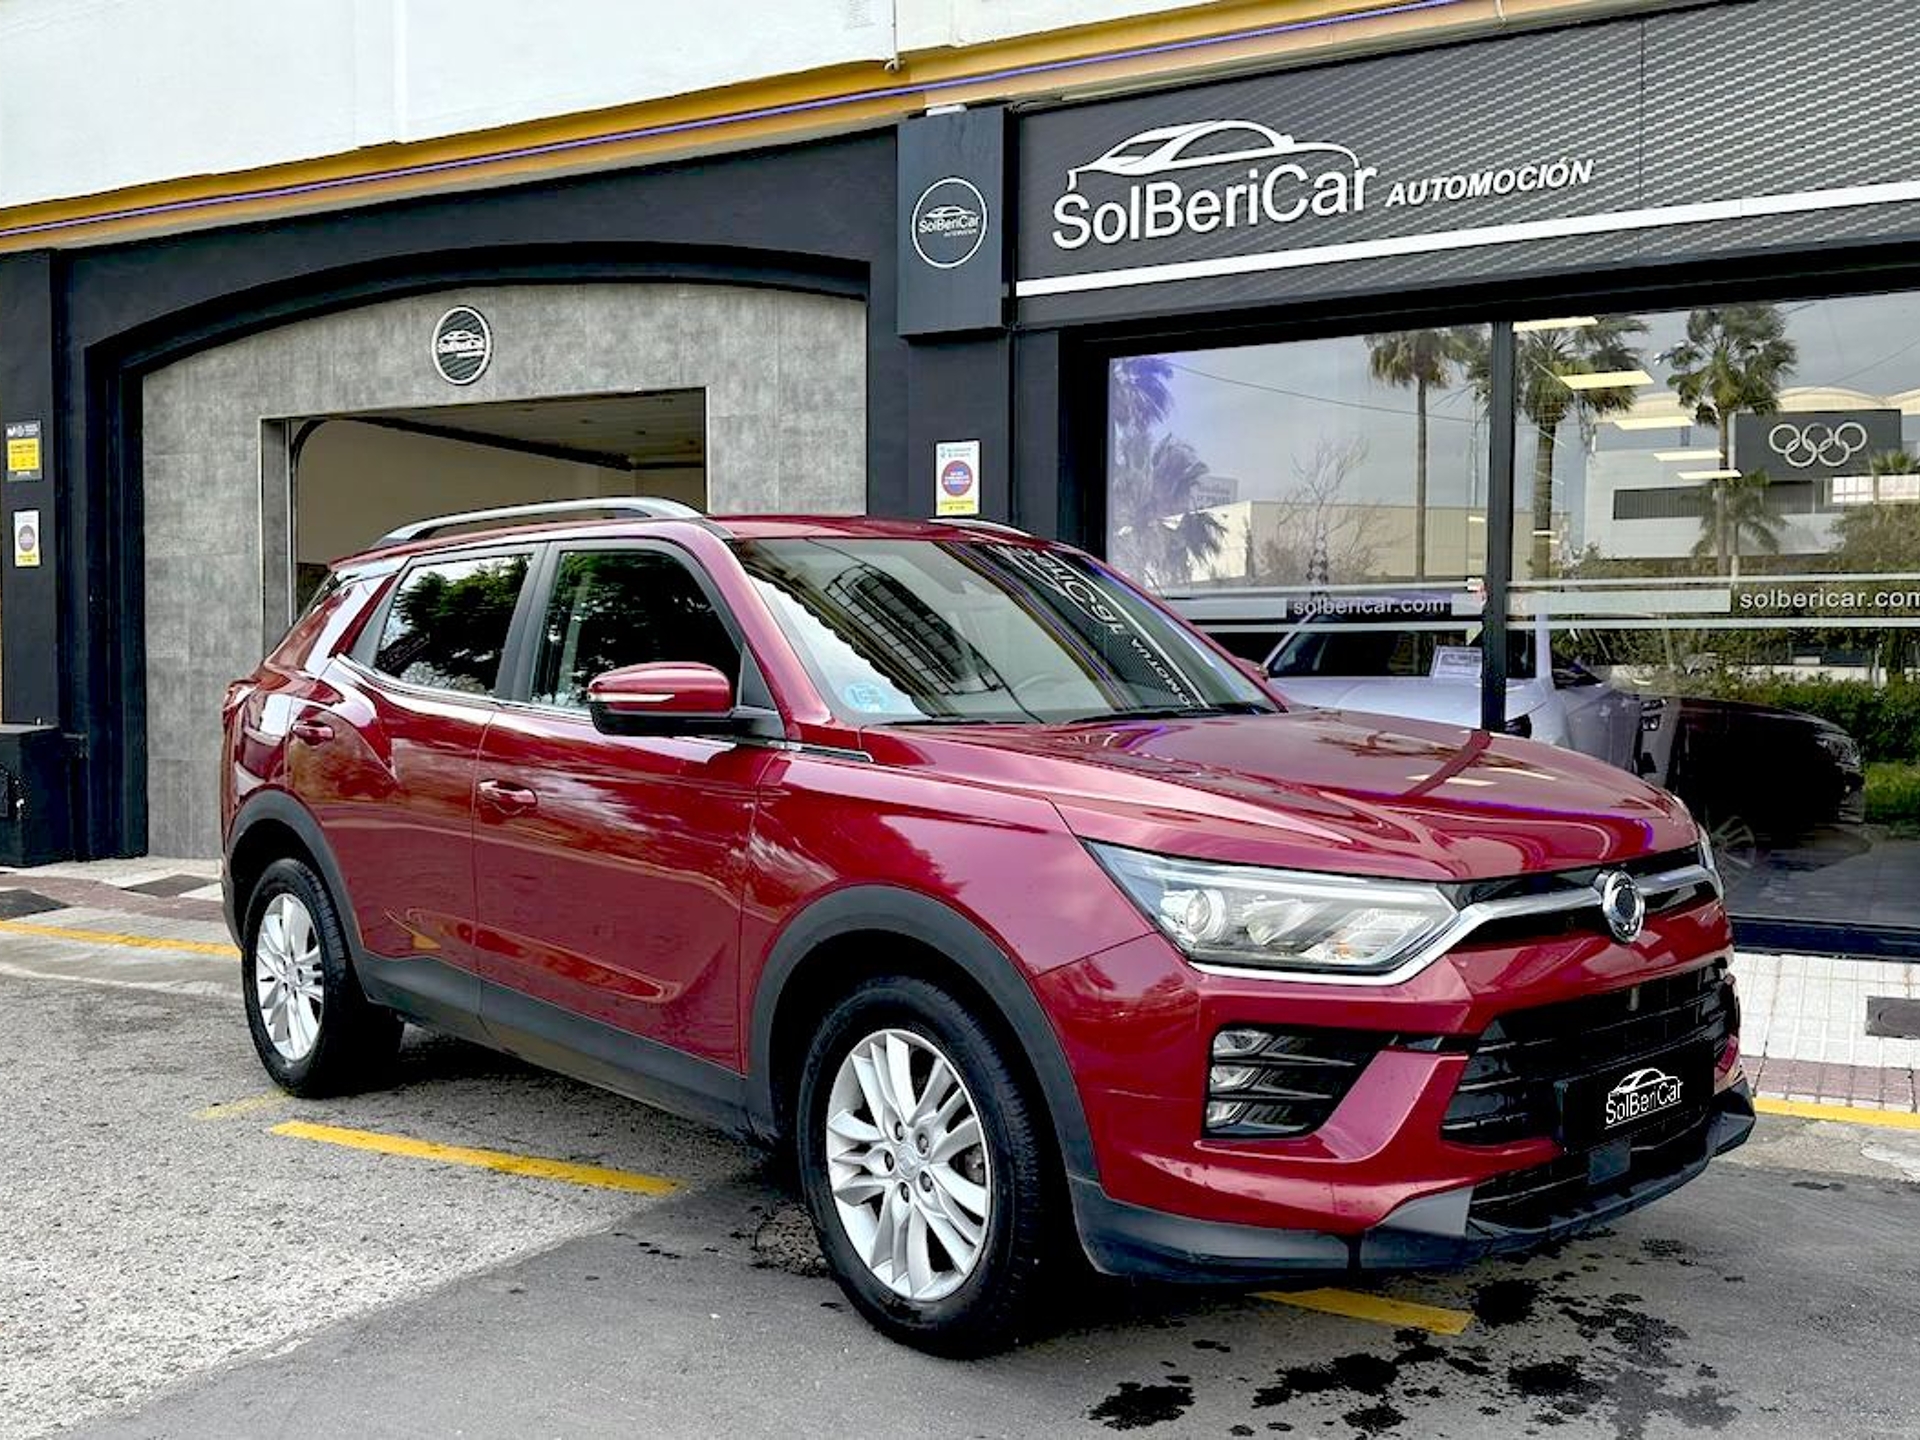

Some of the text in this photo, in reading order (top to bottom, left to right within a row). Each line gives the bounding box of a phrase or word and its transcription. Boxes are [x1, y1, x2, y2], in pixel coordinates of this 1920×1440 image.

[1051, 156, 1595, 250] SolBeriCar AUTOMOCIÓN
[918, 215, 980, 234] SolBeriCar
[1293, 594, 1446, 616] solbericar.com
[1737, 588, 1920, 609] solbericar.com
[1605, 1081, 1684, 1125] SolBeriCar
